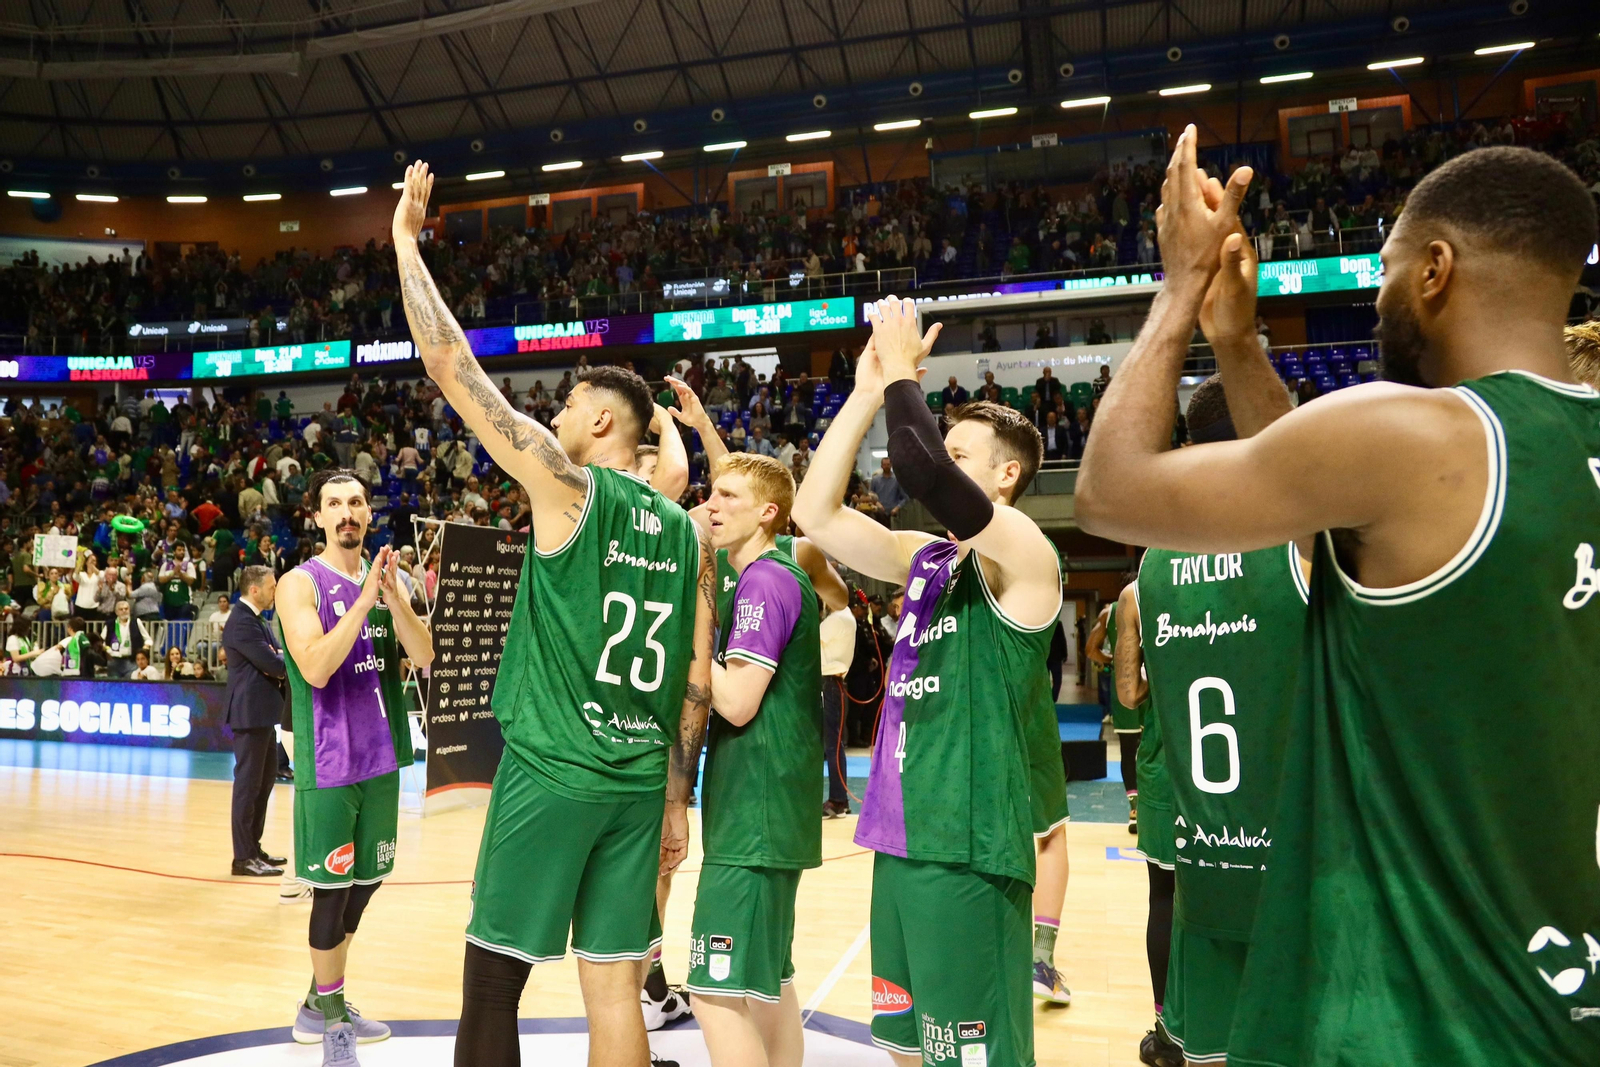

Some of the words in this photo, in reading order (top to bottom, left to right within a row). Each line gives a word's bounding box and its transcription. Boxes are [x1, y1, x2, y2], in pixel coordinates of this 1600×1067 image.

[1262, 260, 1319, 280] JORNADA
[1340, 257, 1375, 274] Dom.
[673, 288, 697, 296] Unicaja
[1279, 273, 1302, 295] 30
[670, 310, 715, 327] JORNADA
[731, 308, 760, 323] Dom.
[762, 304, 792, 319] 21.04
[809, 308, 827, 319] liga
[809, 315, 847, 326] endesa
[142, 326, 169, 335] Unicaja
[514, 320, 586, 341] UNICAJA
[585, 319, 609, 335] VS
[683, 321, 702, 340] 30
[357, 340, 412, 363] PRÓXIMO
[518, 334, 603, 353] BASKONIA
[68, 356, 134, 370] UNICAJA
[134, 355, 155, 369] VS
[215, 360, 232, 377] 30
[70, 368, 149, 381] BASKONIA
[461, 565, 482, 574] endesa
[497, 567, 518, 576] endesa
[1170, 552, 1243, 586] TAYLOR
[169, 584, 179, 593] 45
[441, 578, 464, 587] endesa
[479, 580, 500, 589] endesa
[457, 609, 480, 617] endesa
[435, 623, 459, 632] endesa
[476, 623, 497, 632] endesa
[735, 613, 760, 633] laga
[1155, 610, 1257, 647] Benahavis
[595, 591, 673, 692] 23
[455, 653, 478, 662] endesa
[433, 668, 458, 677] endesa
[474, 667, 496, 676] endesa
[373, 687, 387, 718] 1
[452, 697, 476, 707] endesa
[0, 698, 36, 730] ES
[40, 699, 191, 738] SOCIALES
[431, 713, 456, 723] endesa
[472, 710, 494, 720] endesa
[607, 712, 662, 733] Andalucía
[1188, 676, 1240, 794] 6
[436, 744, 468, 755] #LigaEndesa
[894, 721, 906, 773] 4
[926, 1021, 957, 1044] má
[961, 1028, 979, 1036] acb
[923, 1030, 958, 1061] laga
